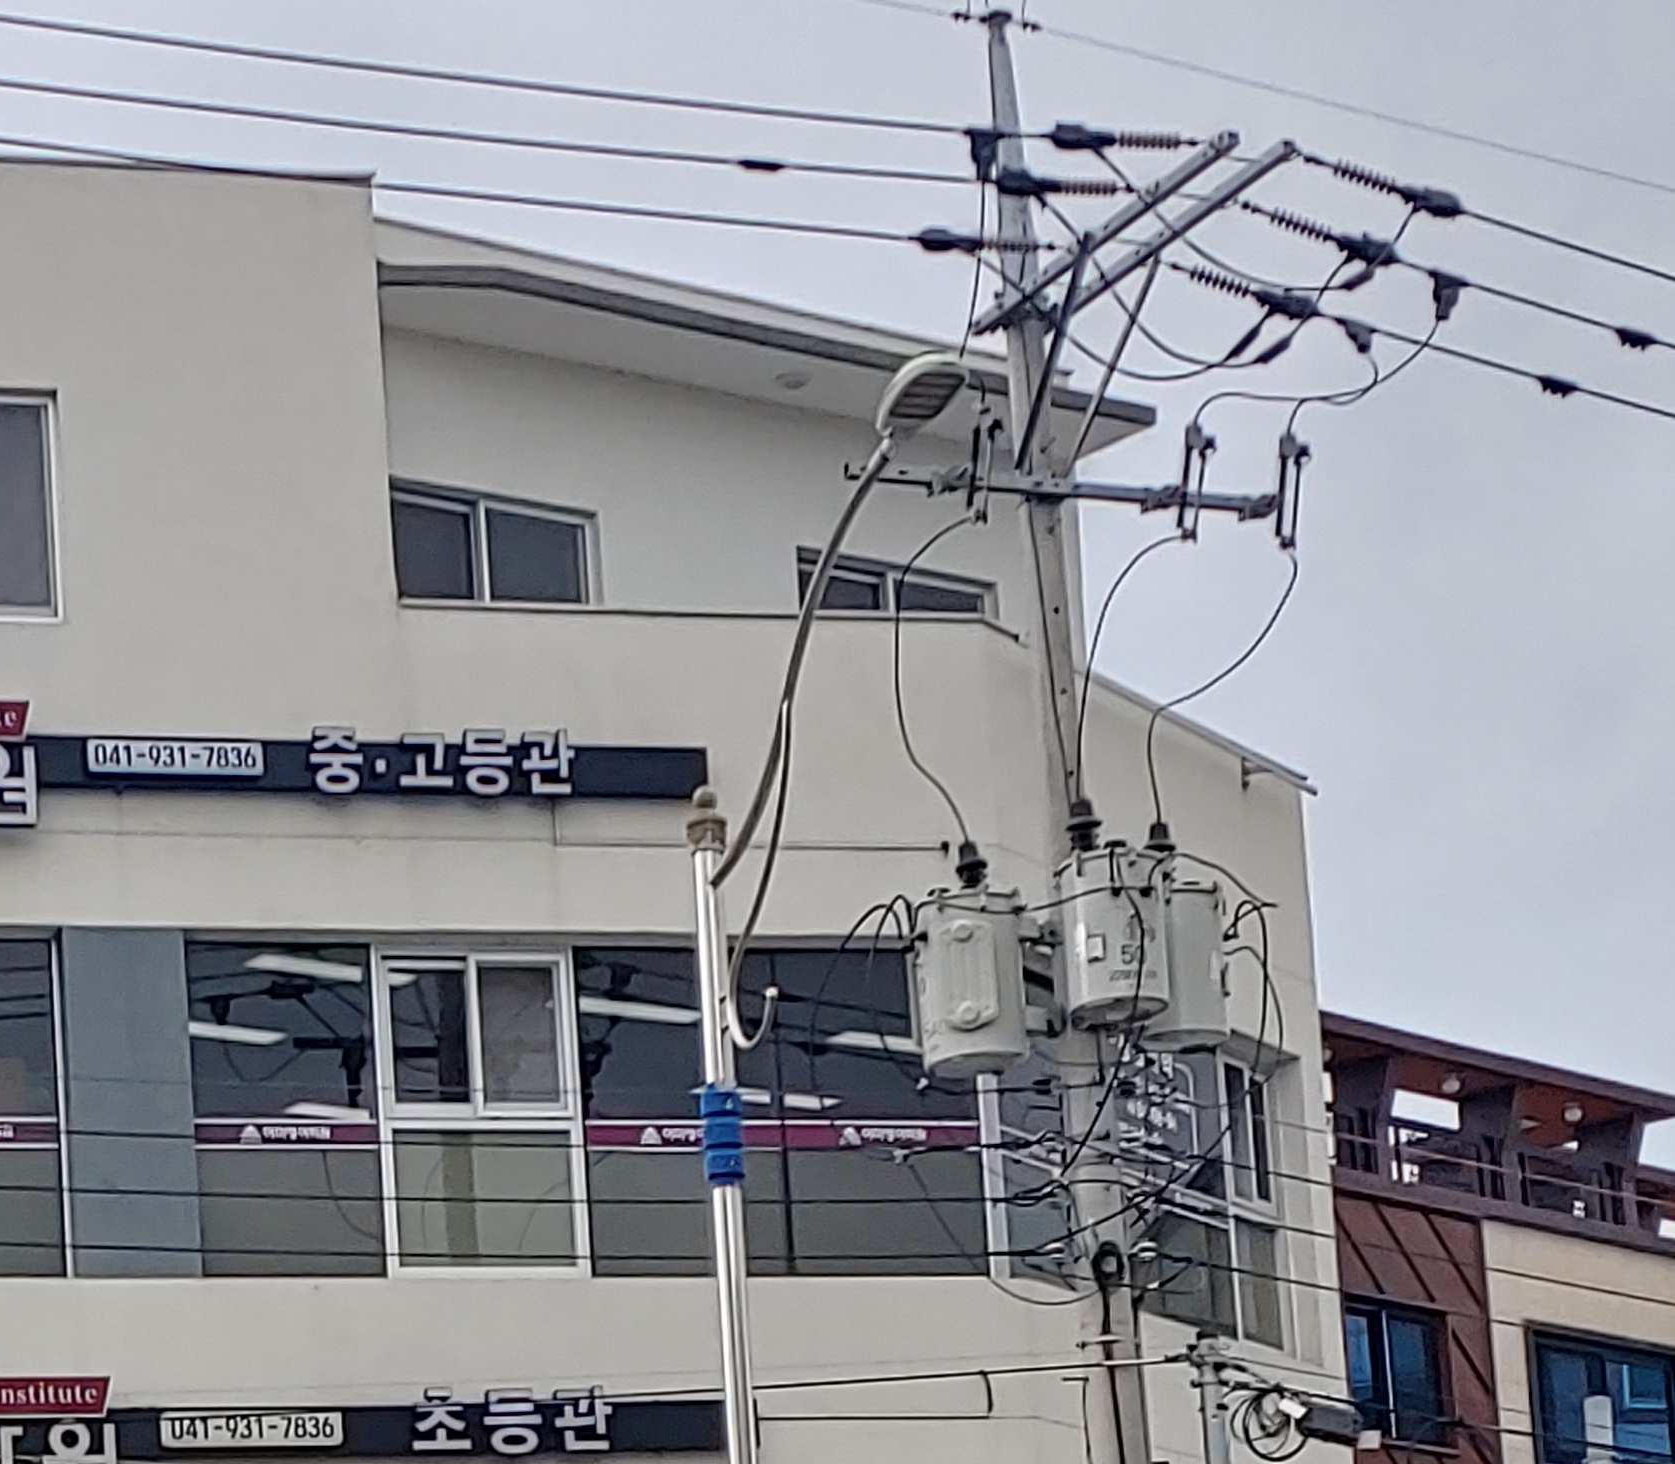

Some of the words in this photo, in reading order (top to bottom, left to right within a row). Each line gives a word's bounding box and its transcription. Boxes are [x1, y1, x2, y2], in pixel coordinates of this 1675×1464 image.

[94, 743, 257, 769] 041-931-7836
[171, 1415, 335, 1441] 041-931-7836
[411, 1386, 612, 1456] 초등관
